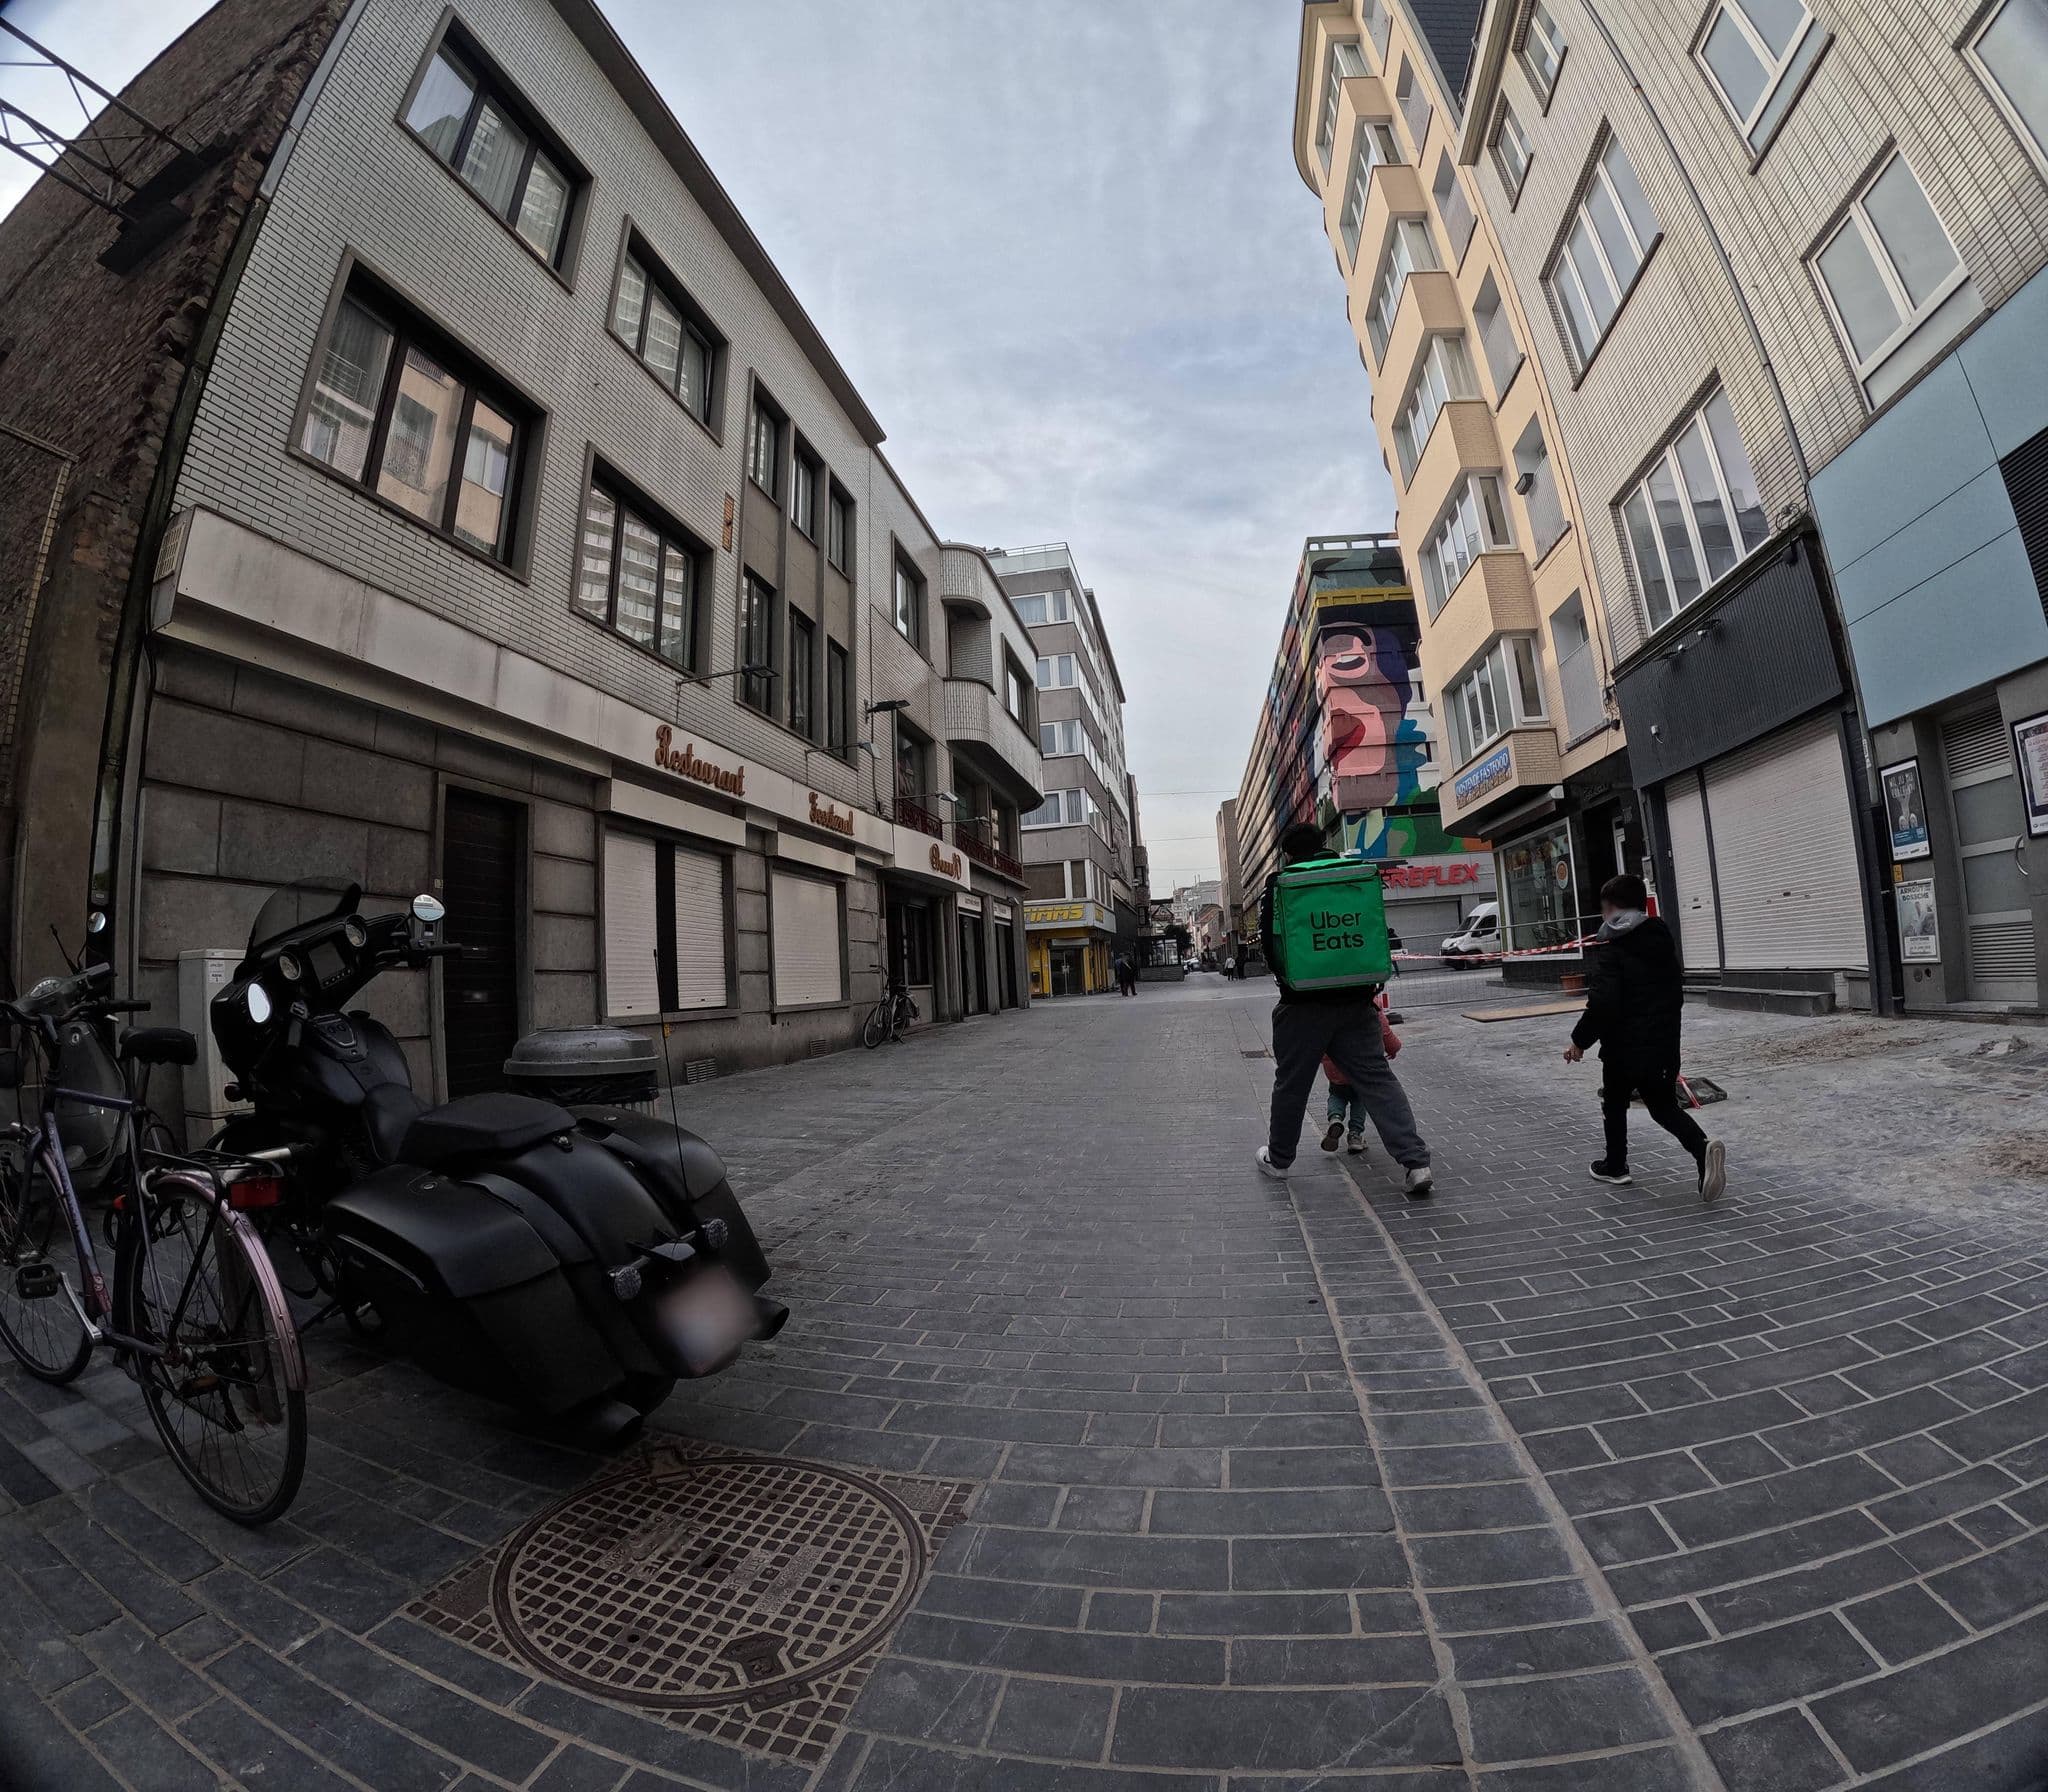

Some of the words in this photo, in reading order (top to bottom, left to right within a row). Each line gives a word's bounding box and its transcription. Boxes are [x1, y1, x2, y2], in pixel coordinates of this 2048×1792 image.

[654, 724, 746, 796] Restaurant
[1310, 911, 1362, 930] Uber
[1313, 931, 1365, 952] Eats
